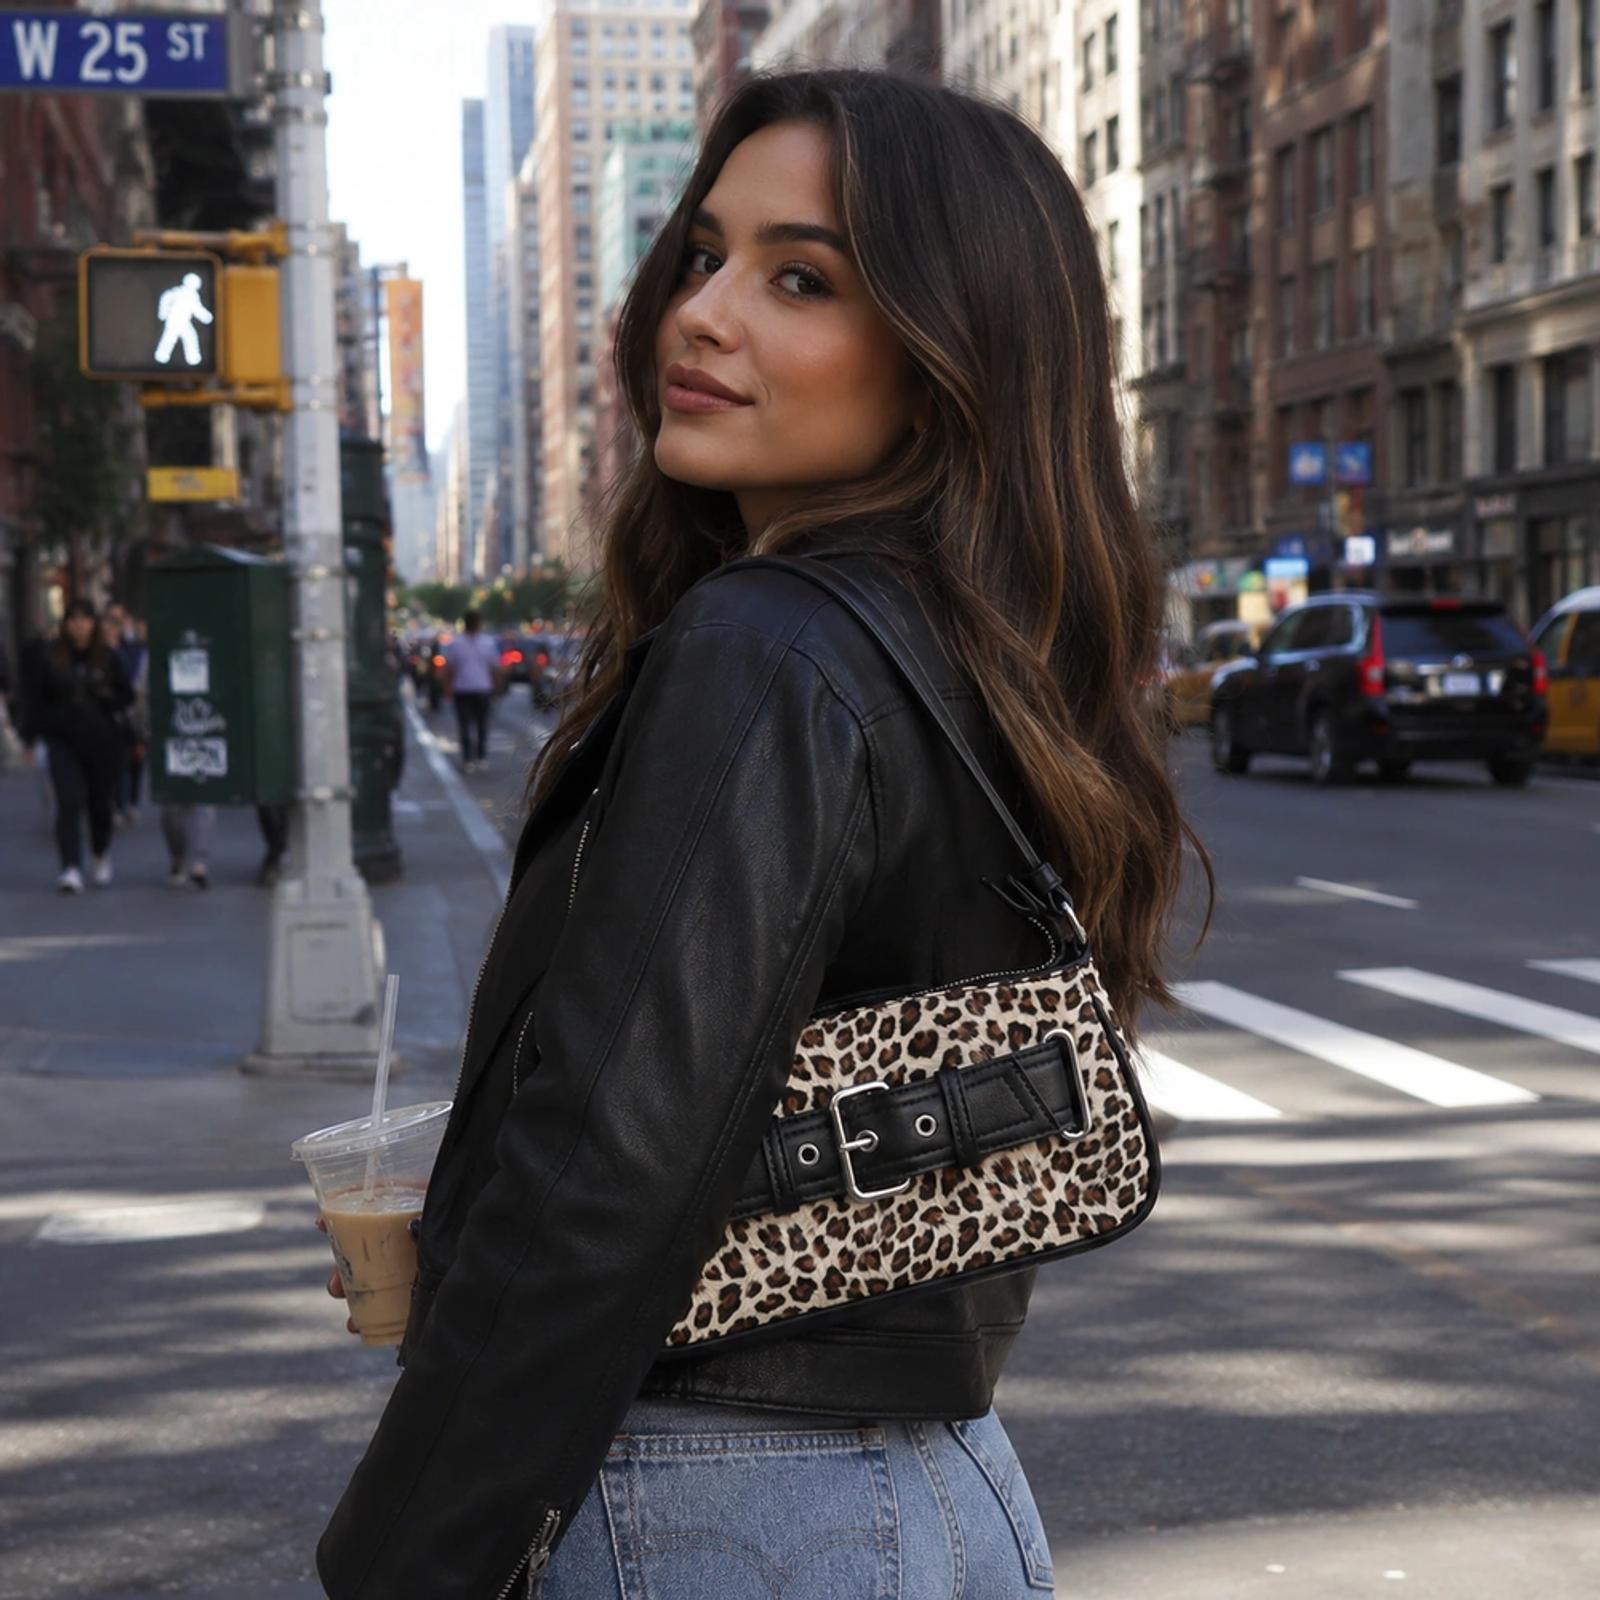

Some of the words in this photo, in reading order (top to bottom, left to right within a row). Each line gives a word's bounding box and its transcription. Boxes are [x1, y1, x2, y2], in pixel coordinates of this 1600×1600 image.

[12, 20, 59, 80] W
[79, 21, 148, 83] 25
[167, 22, 208, 61] ST
